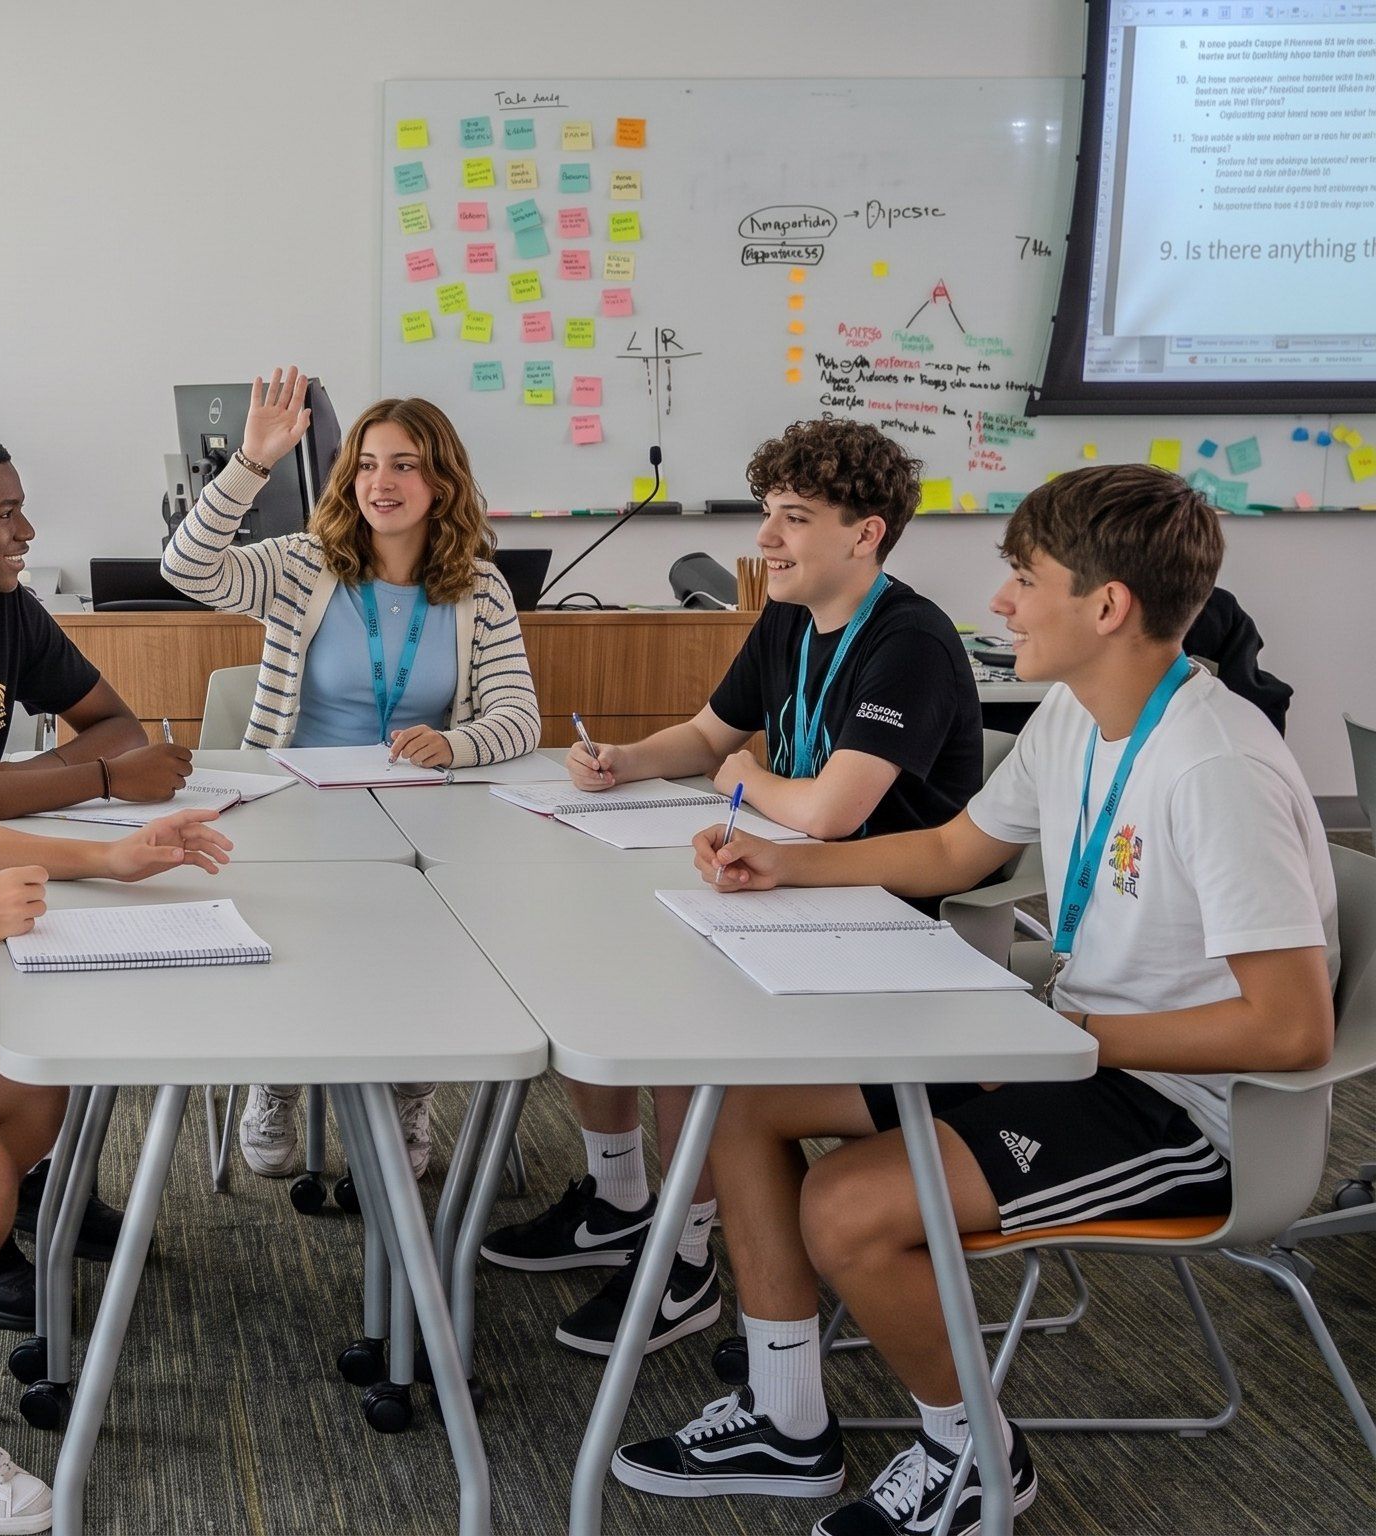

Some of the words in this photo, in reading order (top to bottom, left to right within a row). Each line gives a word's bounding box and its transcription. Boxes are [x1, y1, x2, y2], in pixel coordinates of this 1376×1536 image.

[1160, 240, 1178, 260] 9.
[1185, 240, 1201, 260] Is
[1208, 239, 1262, 260] there
[1267, 237, 1357, 264] anything
